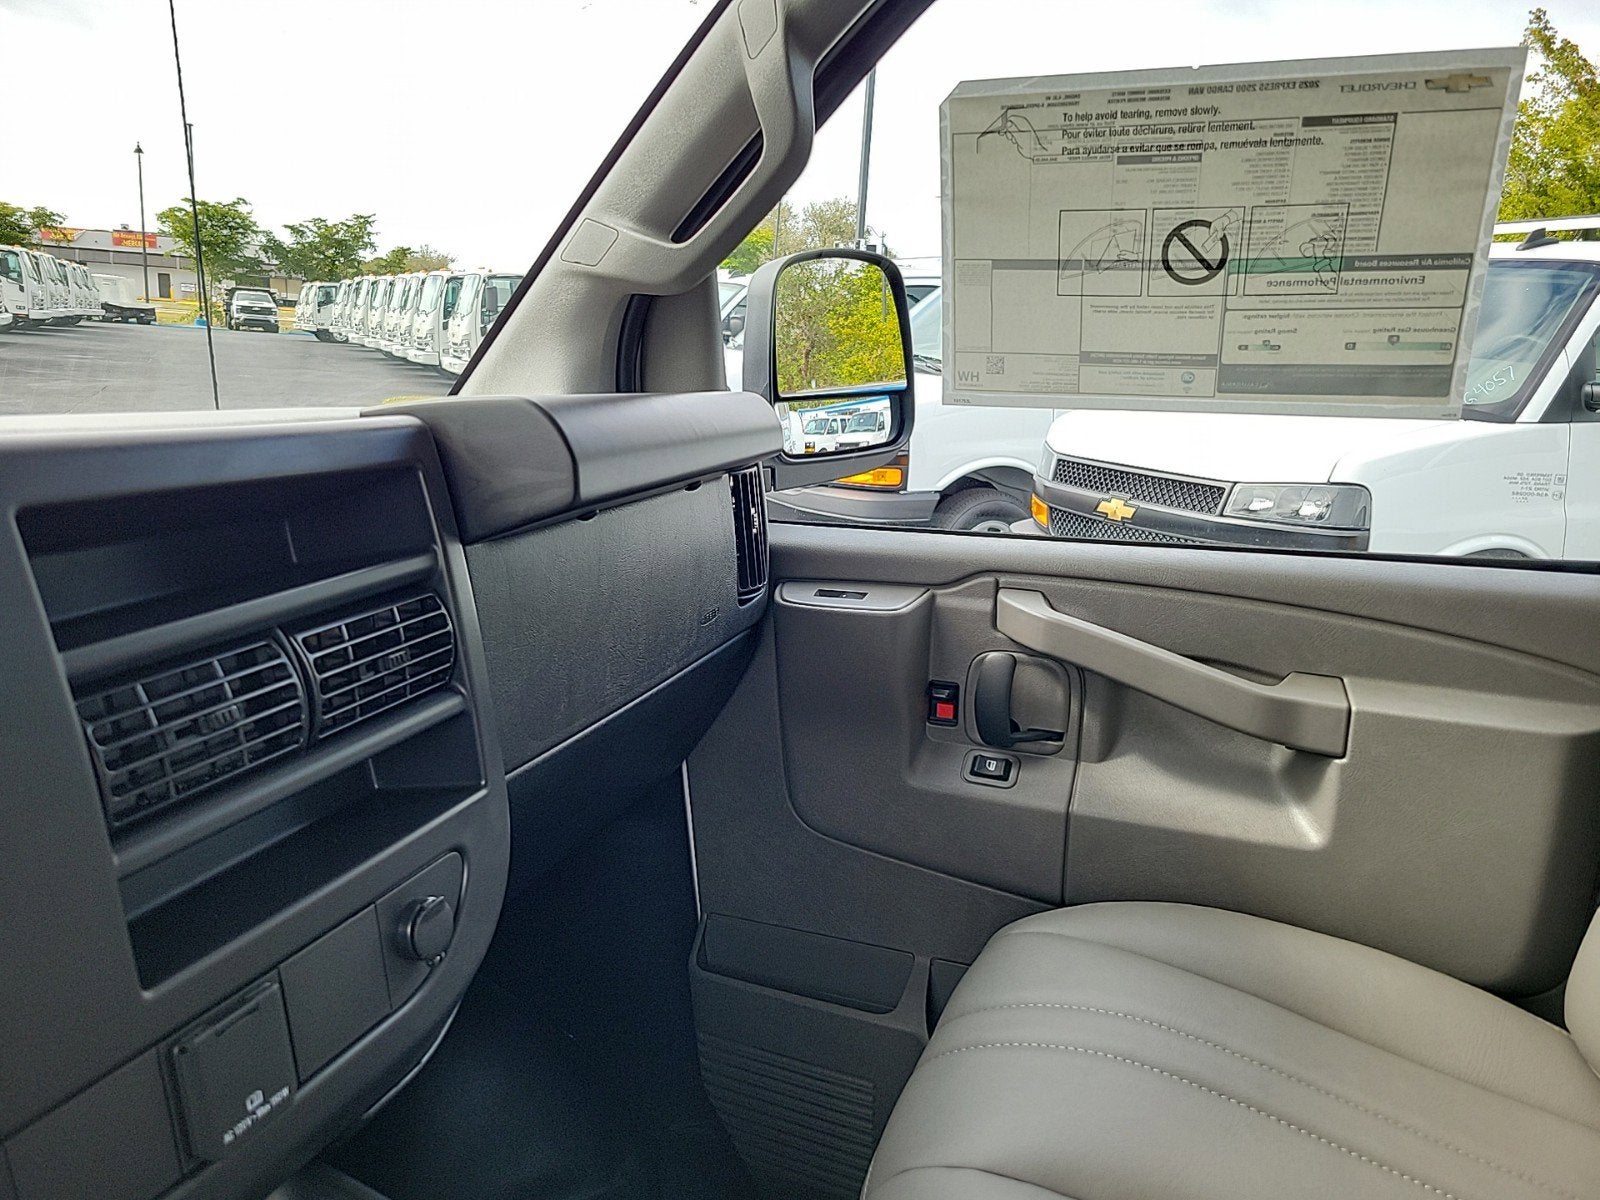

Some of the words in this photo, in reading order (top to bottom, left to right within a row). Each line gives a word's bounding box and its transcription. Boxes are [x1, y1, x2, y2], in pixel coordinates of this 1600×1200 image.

[1062, 112, 1073, 122] To
[1075, 111, 1093, 123] help
[1095, 110, 1118, 121] avoid
[1120, 108, 1153, 120] tearing,
[1155, 107, 1188, 118] remove
[1190, 104, 1221, 117] slowly.
[1062, 129, 1081, 139] Pour
[1083, 126, 1106, 138] éviter
[1108, 125, 1130, 137] toute
[1132, 124, 1176, 137] déchirure,
[1178, 122, 1206, 134] retirer
[1208, 120, 1255, 132] lentement.
[1062, 146, 1080, 156] Para
[1082, 143, 1120, 157] ayudarse
[1129, 142, 1153, 153] evitar
[1156, 142, 1172, 154] que
[1174, 143, 1185, 151] se
[1186, 140, 1217, 152] rompa,
[1220, 138, 1267, 149] remuévala
[1269, 135, 1324, 147] lentamente.
